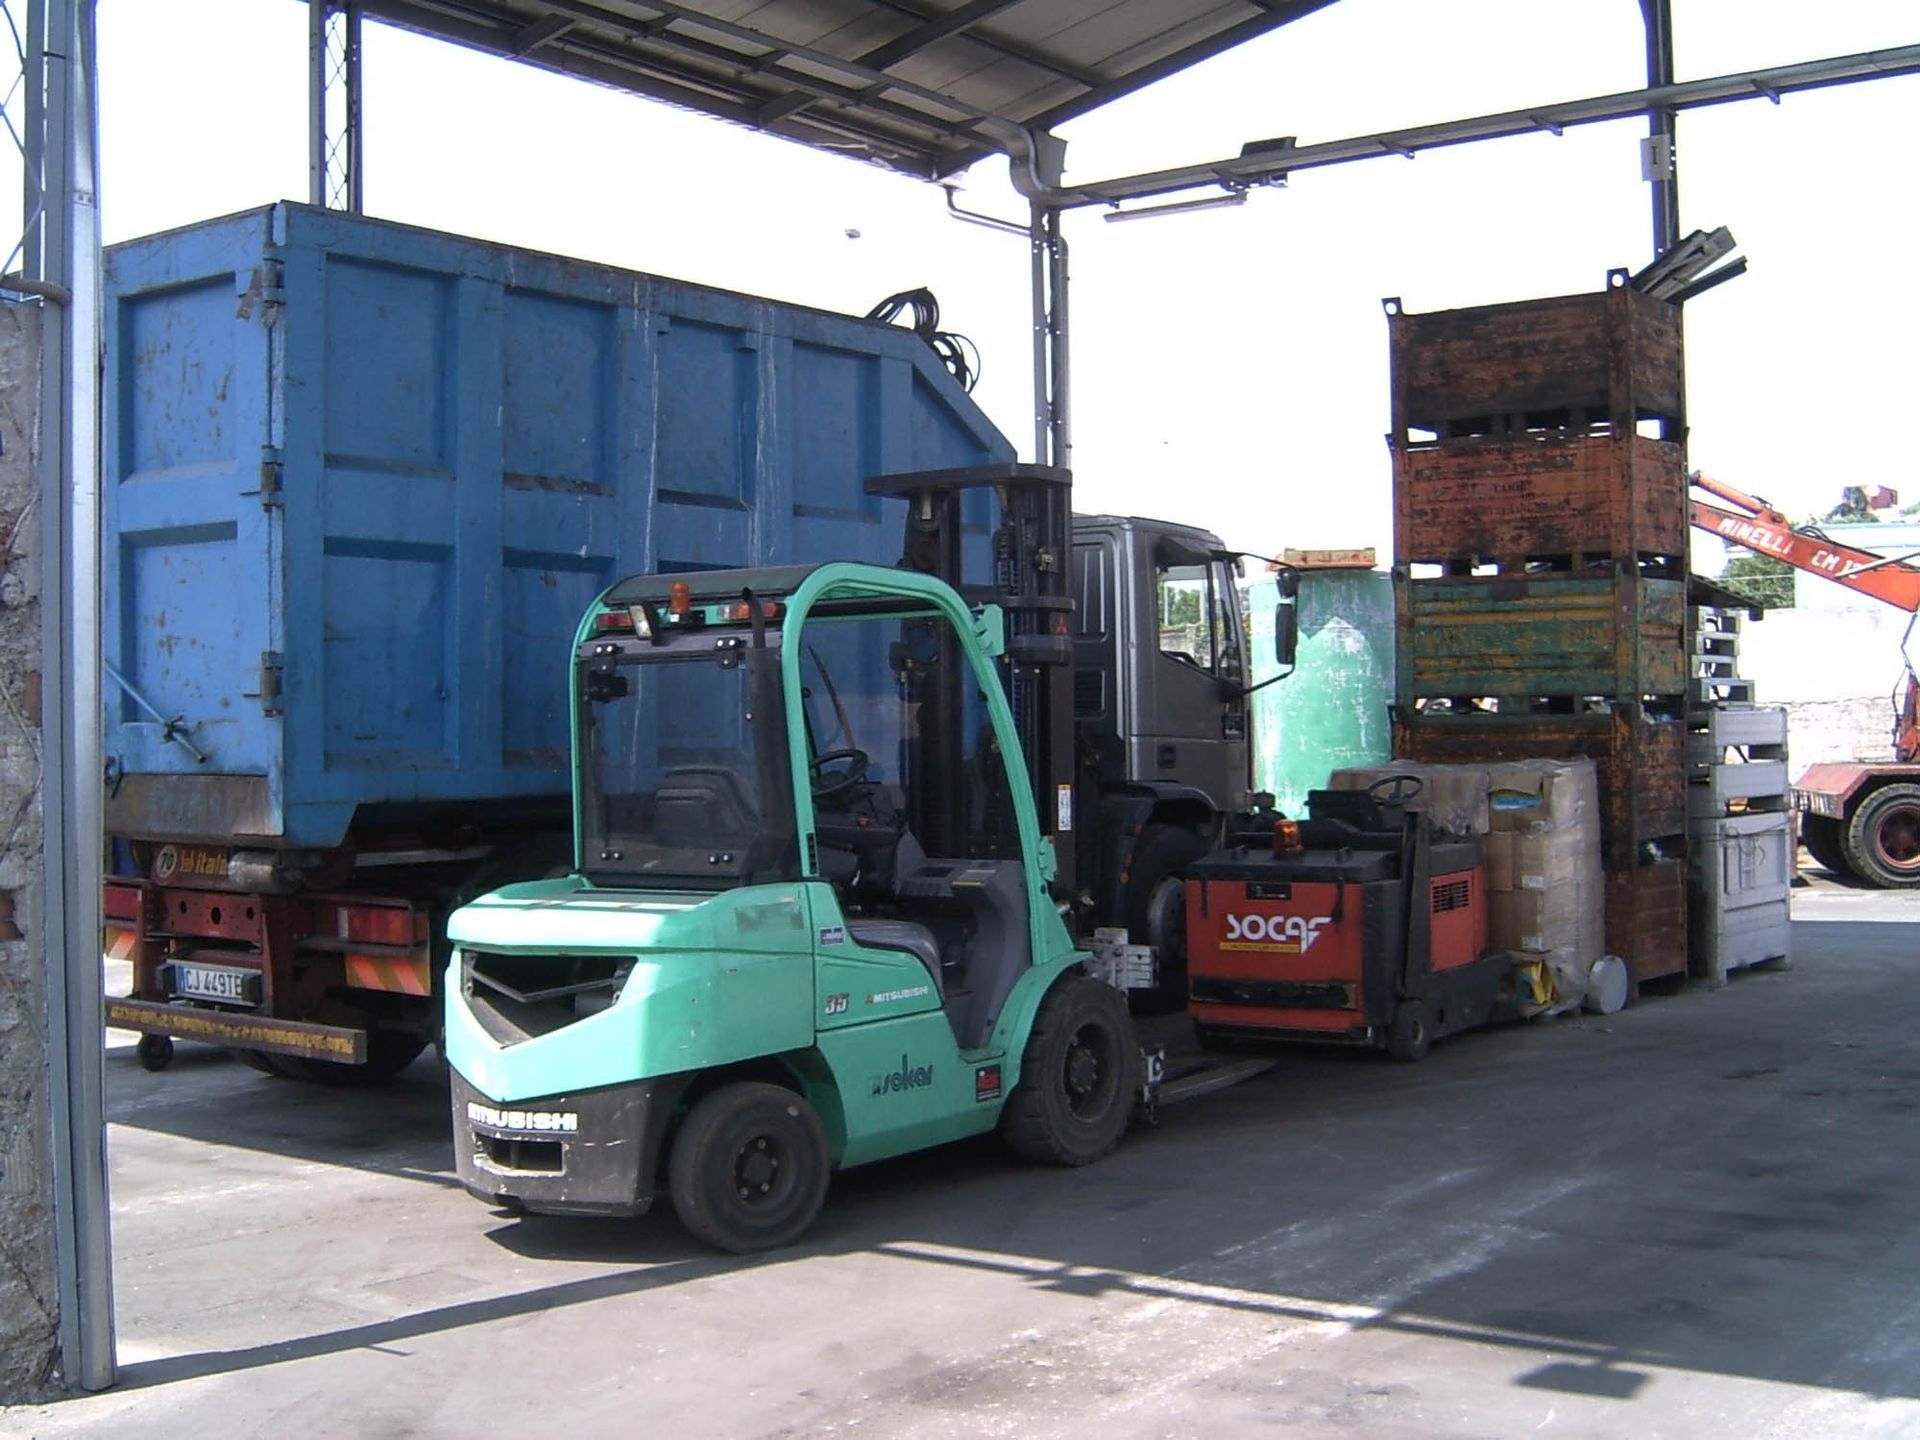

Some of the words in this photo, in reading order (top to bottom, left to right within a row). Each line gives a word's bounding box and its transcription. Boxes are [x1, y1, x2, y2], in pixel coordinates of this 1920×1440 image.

[1718, 518, 1793, 554] MINELLI
[162, 851, 174, 873] 70
[873, 985, 929, 1004] MITSUBISHI
[467, 1101, 578, 1131] MITSUBISHI
